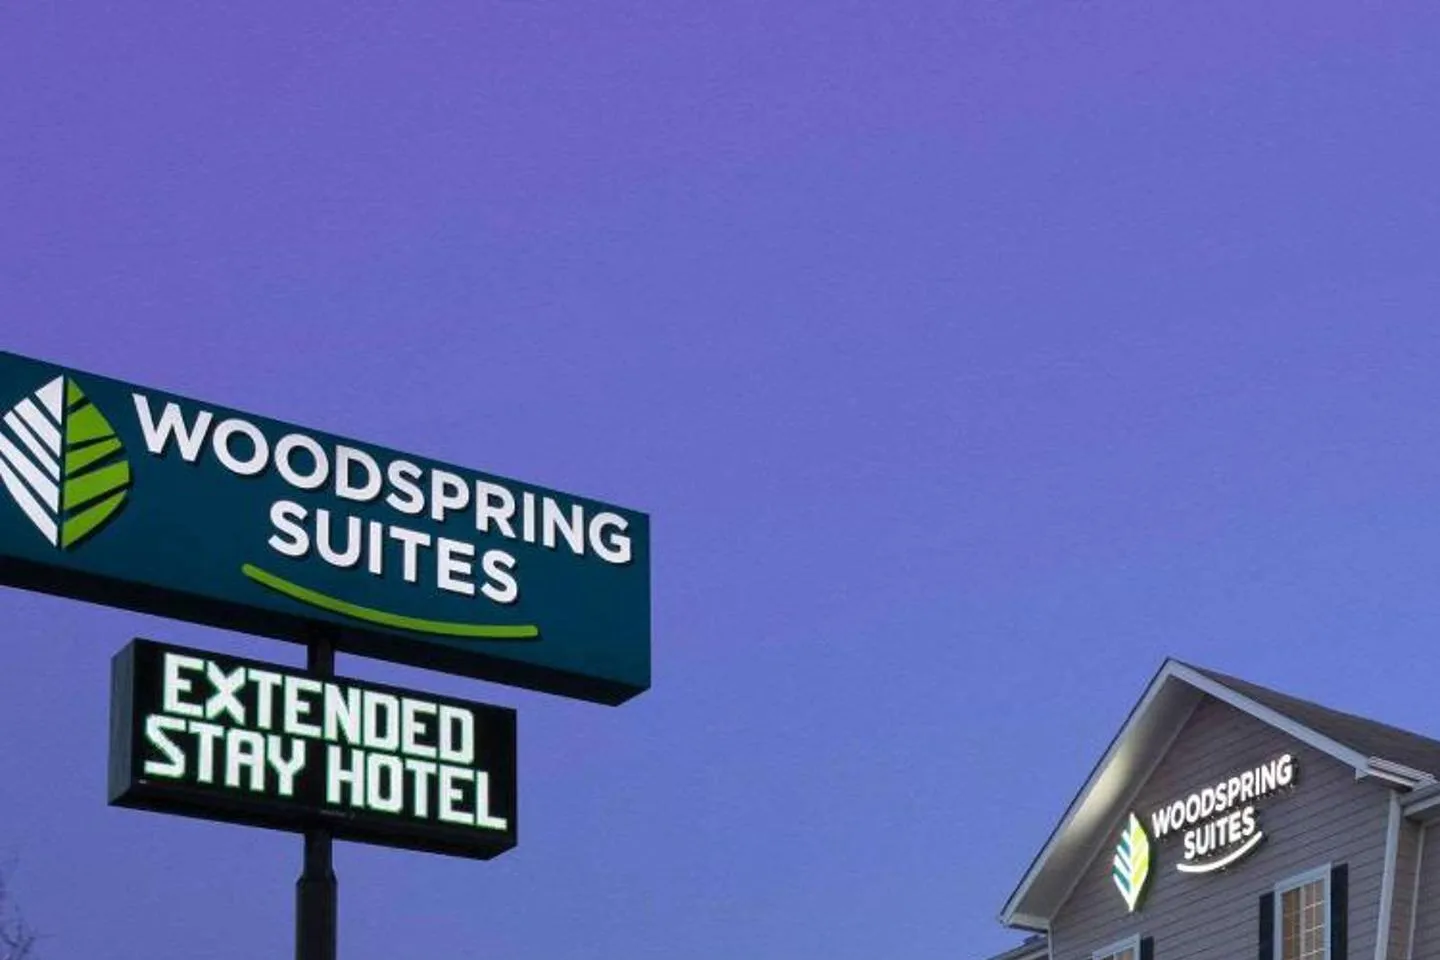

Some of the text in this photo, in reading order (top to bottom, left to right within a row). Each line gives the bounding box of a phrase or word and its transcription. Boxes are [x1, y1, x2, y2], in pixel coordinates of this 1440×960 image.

[132, 393, 632, 564] WOODSPRING
[268, 500, 518, 603] SUITES
[163, 652, 475, 765] EXTENDED
[144, 713, 507, 830] STAY HOTEL
[1152, 753, 1293, 839] WOODSPRING
[1184, 806, 1256, 860] SUITES
